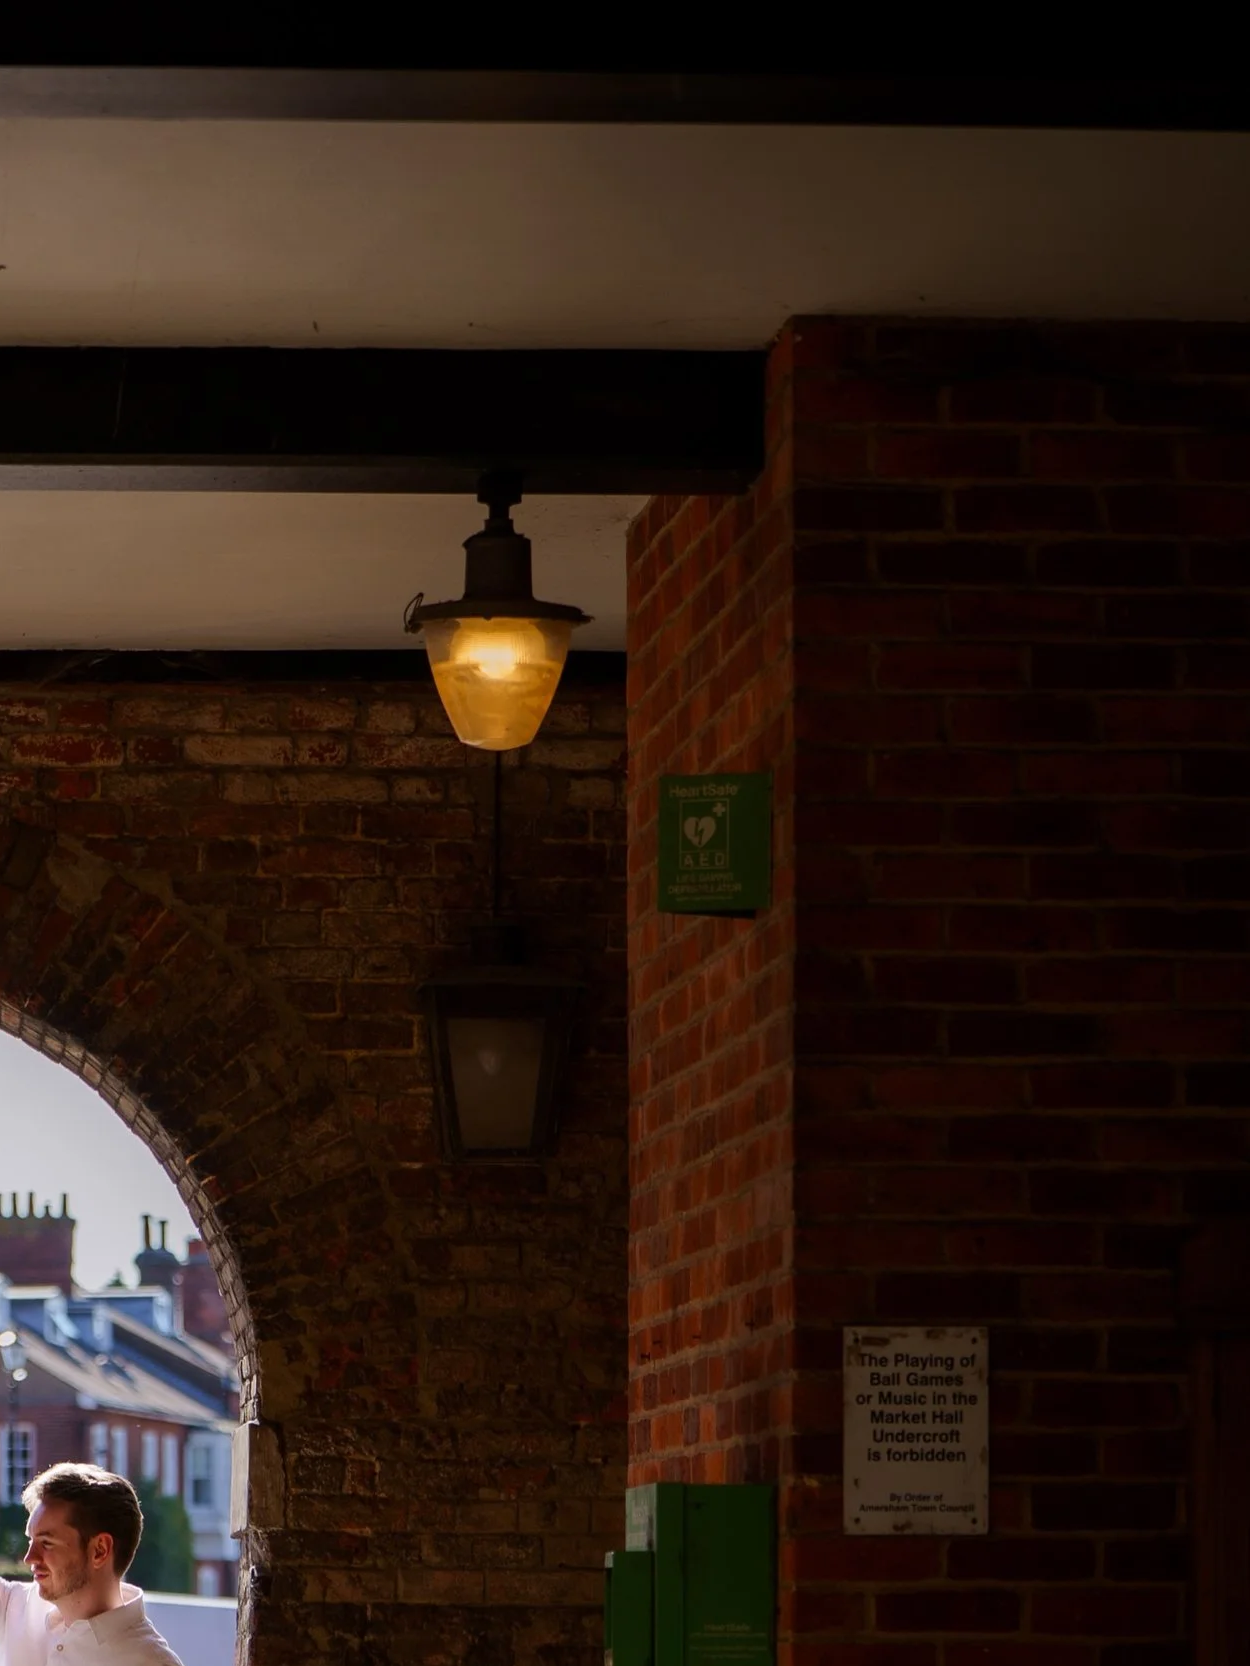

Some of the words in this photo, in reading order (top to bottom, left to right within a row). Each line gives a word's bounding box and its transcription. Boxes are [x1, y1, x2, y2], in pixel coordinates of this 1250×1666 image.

[859, 1353, 888, 1367] The
[894, 1353, 955, 1371] Playing
[960, 1353, 976, 1368] of
[870, 1372, 900, 1386] Ball
[906, 1372, 964, 1386] Games
[856, 1394, 873, 1405] or
[879, 1391, 927, 1405] Music
[933, 1392, 946, 1405] in
[952, 1392, 978, 1405] the
[871, 1410, 926, 1424] Market
[932, 1410, 963, 1424] Hall
[873, 1429, 960, 1443] Undercroft
[868, 1448, 881, 1461] is
[886, 1448, 966, 1462] forbidden
[890, 1493, 901, 1503] By
[905, 1493, 930, 1502] Order
[934, 1493, 943, 1502] of
[859, 1504, 909, 1513] Amersham
[911, 1504, 937, 1513] Town
[939, 1504, 975, 1513] Council
